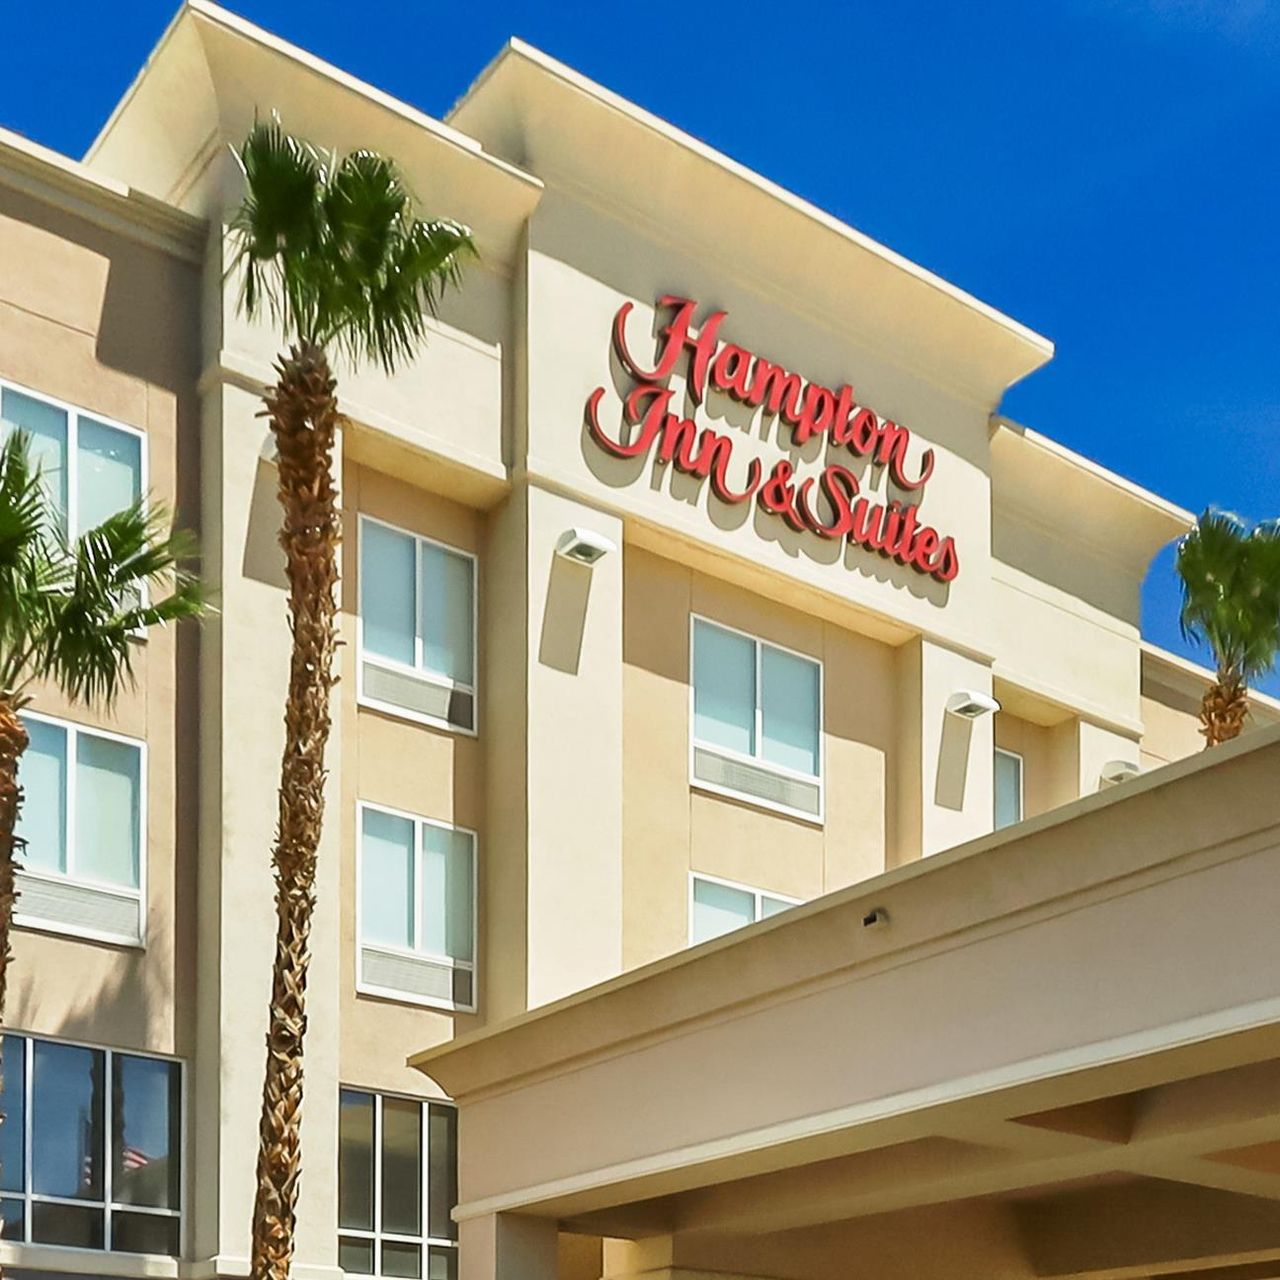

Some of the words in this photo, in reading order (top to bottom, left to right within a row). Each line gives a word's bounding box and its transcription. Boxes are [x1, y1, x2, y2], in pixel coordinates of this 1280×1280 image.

[584, 383, 762, 504] Inn
[759, 458, 807, 533] &
[796, 463, 960, 583] Suites
[612, 294, 934, 490] Hampton
